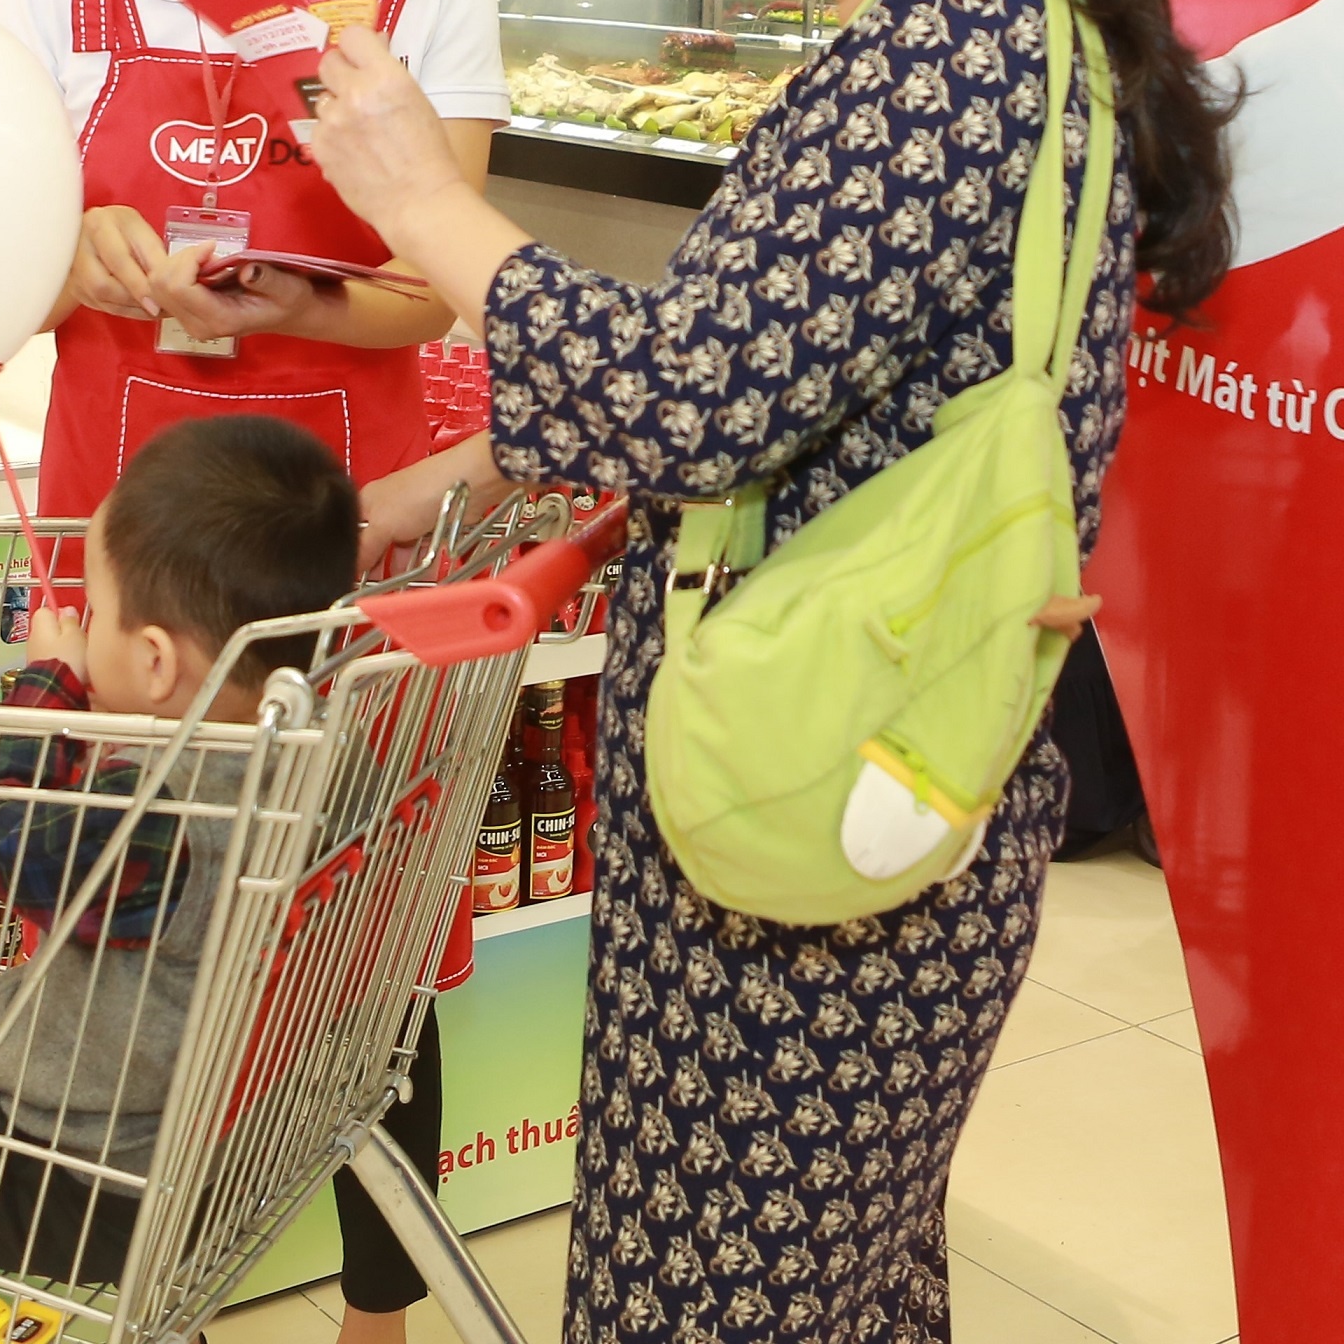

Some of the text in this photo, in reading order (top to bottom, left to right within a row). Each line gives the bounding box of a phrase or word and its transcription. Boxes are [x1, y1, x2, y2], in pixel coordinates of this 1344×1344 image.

[170, 136, 256, 164] MEAT
[1176, 345, 1256, 420] Mát
[1266, 379, 1317, 434] từ
